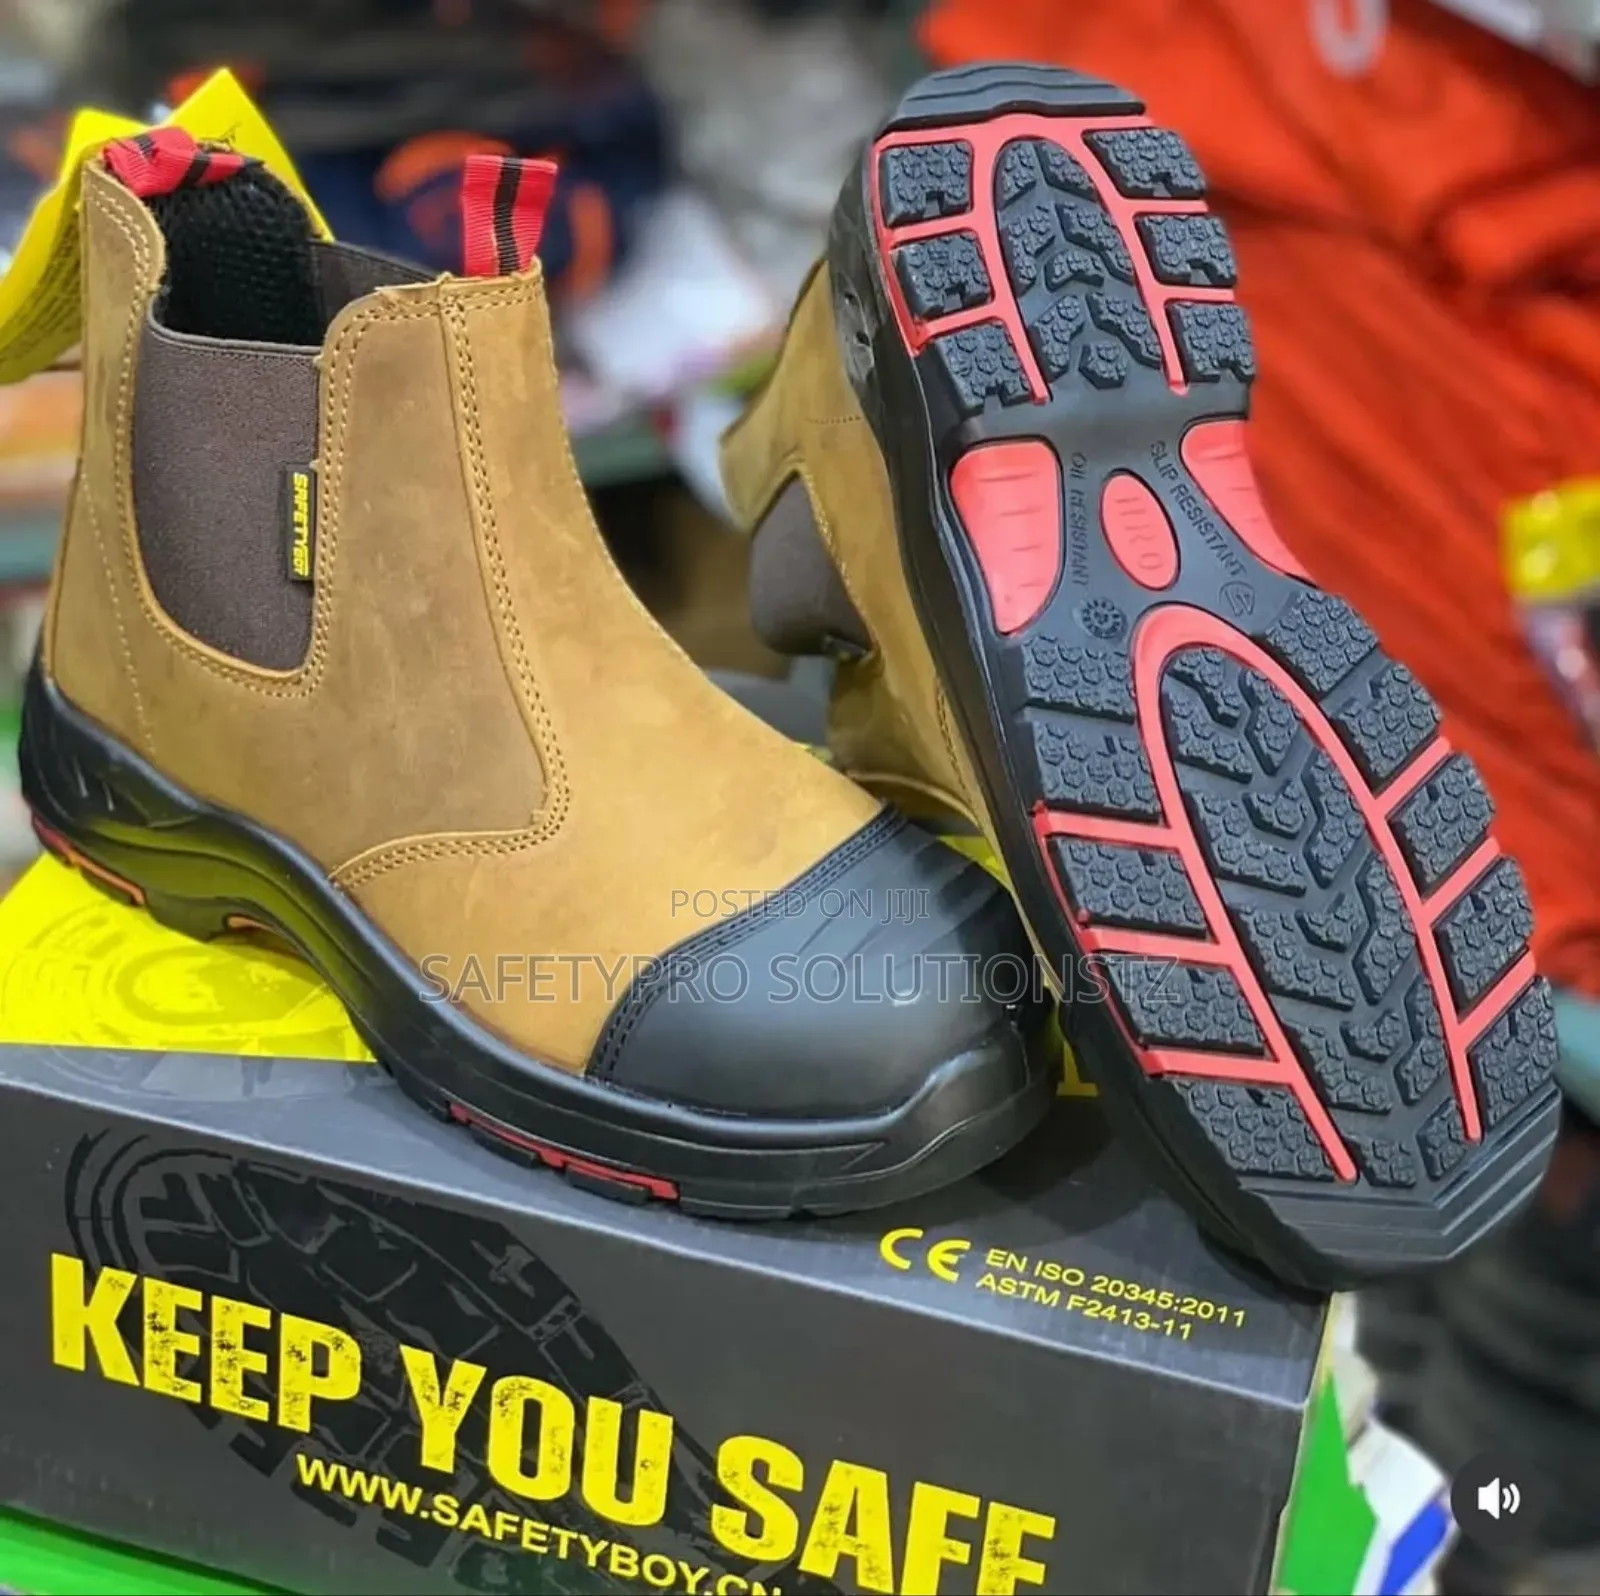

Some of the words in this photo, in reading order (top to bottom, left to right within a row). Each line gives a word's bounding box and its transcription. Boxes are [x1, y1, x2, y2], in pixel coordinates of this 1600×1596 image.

[1150, 440, 1179, 481] SLIP
[1169, 484, 1247, 577] RESISTANT
[879, 1228, 971, 1283] CE
[985, 1248, 1028, 1273] EN
[1034, 1259, 1085, 1287] ISO
[1090, 1275, 1245, 1328] 20345:2011
[975, 1272, 1060, 1307] ASTM
[1066, 1296, 1192, 1340] F2413-11
[51, 1252, 362, 1434] KEEP
[399, 1344, 674, 1527] YOU
